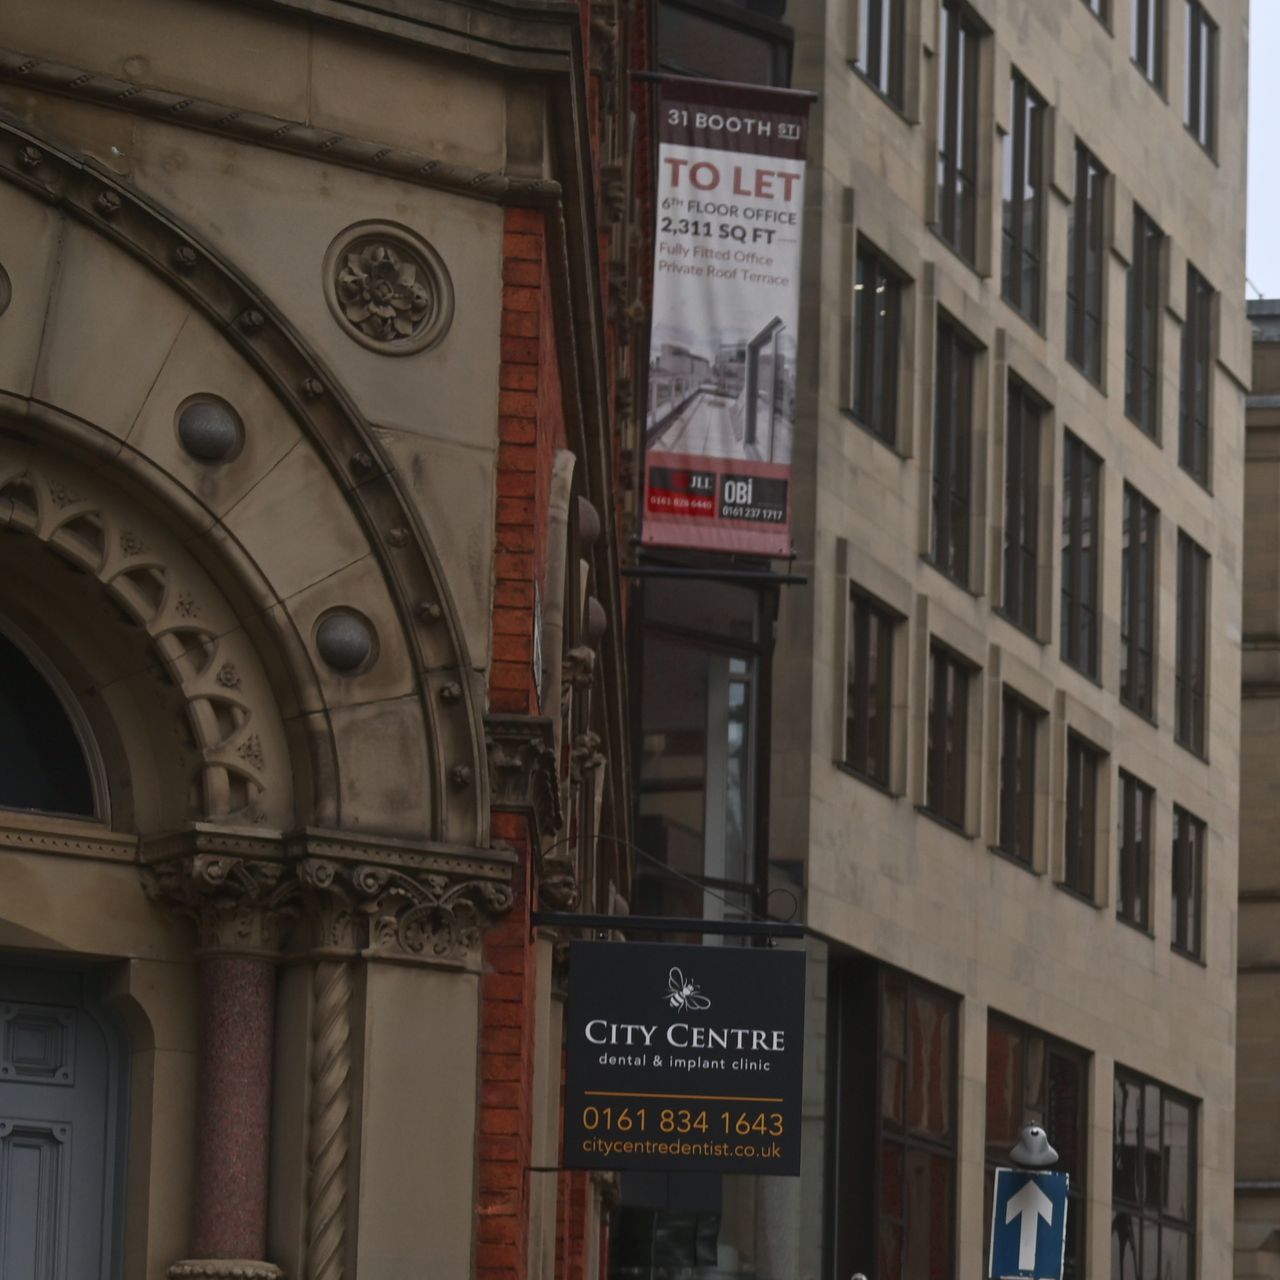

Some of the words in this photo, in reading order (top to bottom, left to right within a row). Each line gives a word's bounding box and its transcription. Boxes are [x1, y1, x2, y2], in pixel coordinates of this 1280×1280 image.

[668, 108, 688, 127] 31
[695, 112, 772, 137] BOOTH
[664, 157, 720, 191] TO
[733, 165, 800, 202] LET
[687, 199, 739, 218] FLOOR
[743, 207, 797, 226] OFFICE
[661, 217, 713, 237] 2,311
[718, 223, 747, 244] SQ
[752, 228, 776, 245] FT
[659, 242, 690, 258] Fully
[693, 245, 730, 261] Fitted
[734, 250, 773, 267] Office
[658, 260, 704, 277] Private
[706, 265, 737, 280] Roof
[741, 270, 789, 286] Terrace
[722, 506, 744, 518] 0161
[744, 507, 761, 519] 237
[762, 508, 783, 521] 1717
[584, 1019, 658, 1046] CITY
[666, 1022, 785, 1052] CENTRE
[598, 1053, 646, 1067] dental
[652, 1055, 663, 1068] &
[669, 1056, 726, 1072] implant
[732, 1058, 771, 1072] clinic
[582, 1106, 648, 1132] 0161
[659, 1109, 709, 1134] 834
[720, 1111, 784, 1137] 1643
[582, 1138, 781, 1159] citycentredentist.co.uk
